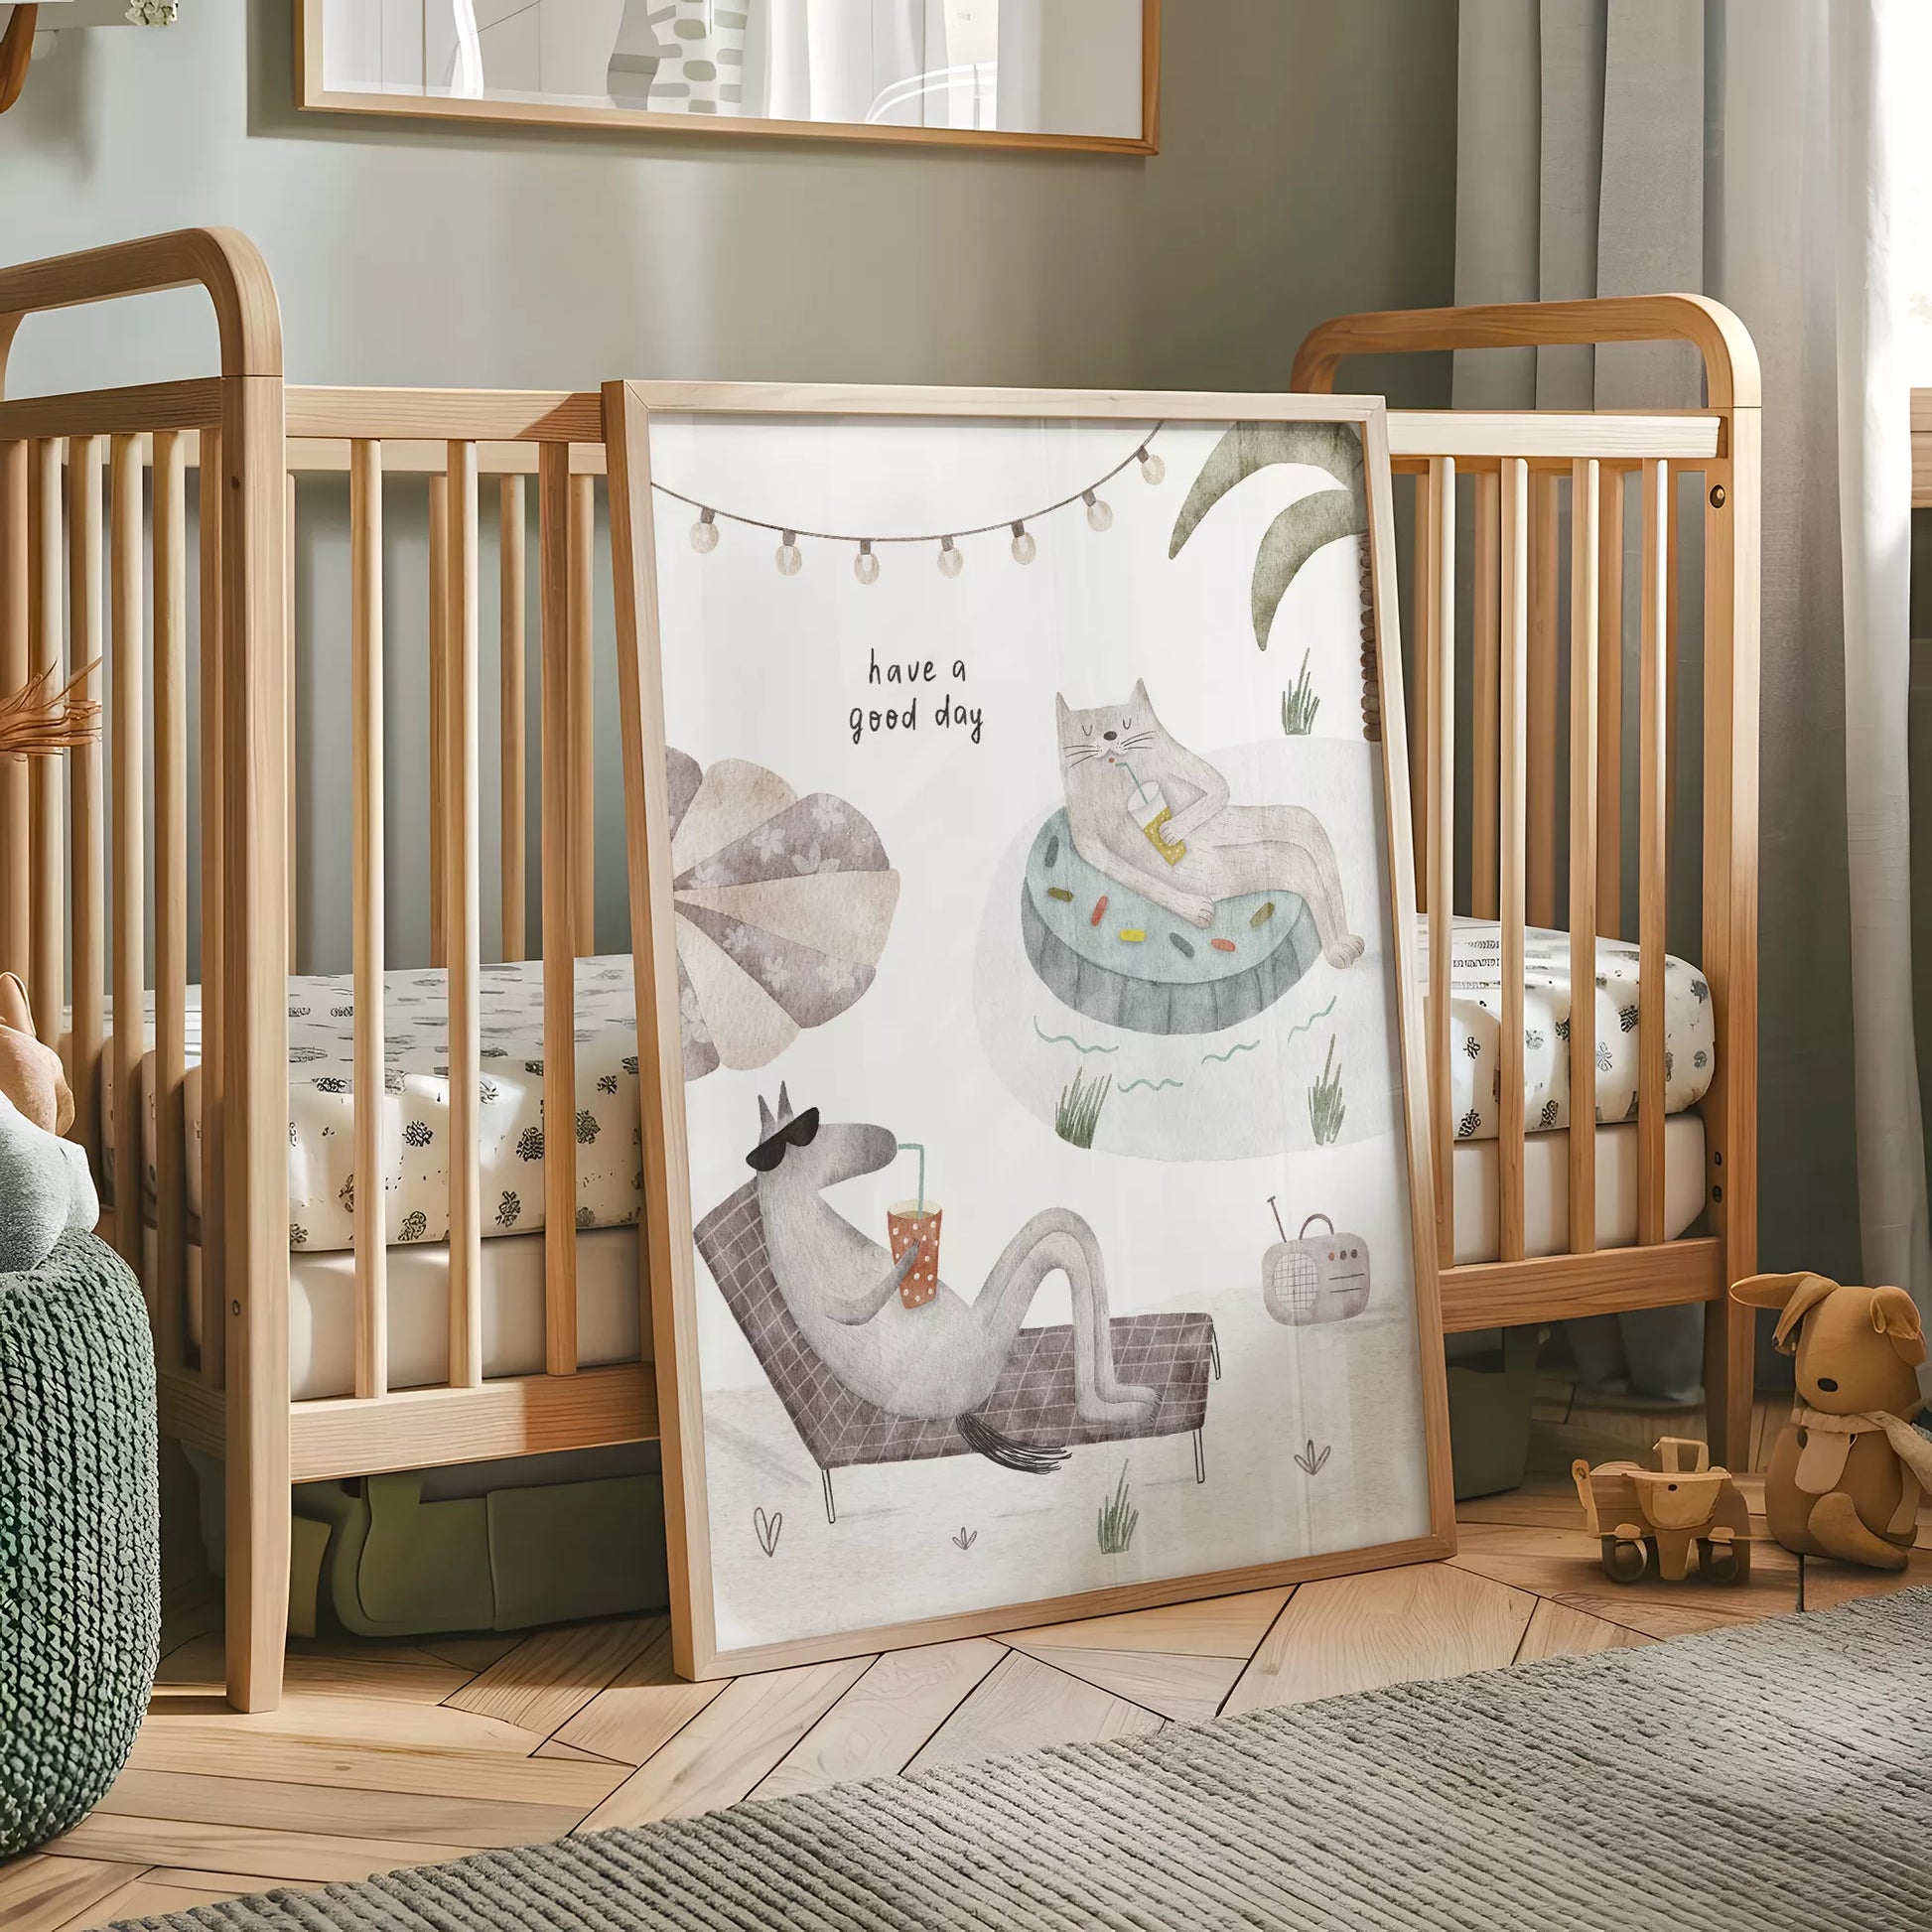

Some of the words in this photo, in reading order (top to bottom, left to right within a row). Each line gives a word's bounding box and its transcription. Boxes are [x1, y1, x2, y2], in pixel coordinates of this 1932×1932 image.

[869, 647, 937, 685] have
[952, 659, 966, 682] a
[849, 697, 917, 746] good
[934, 693, 984, 745] day
